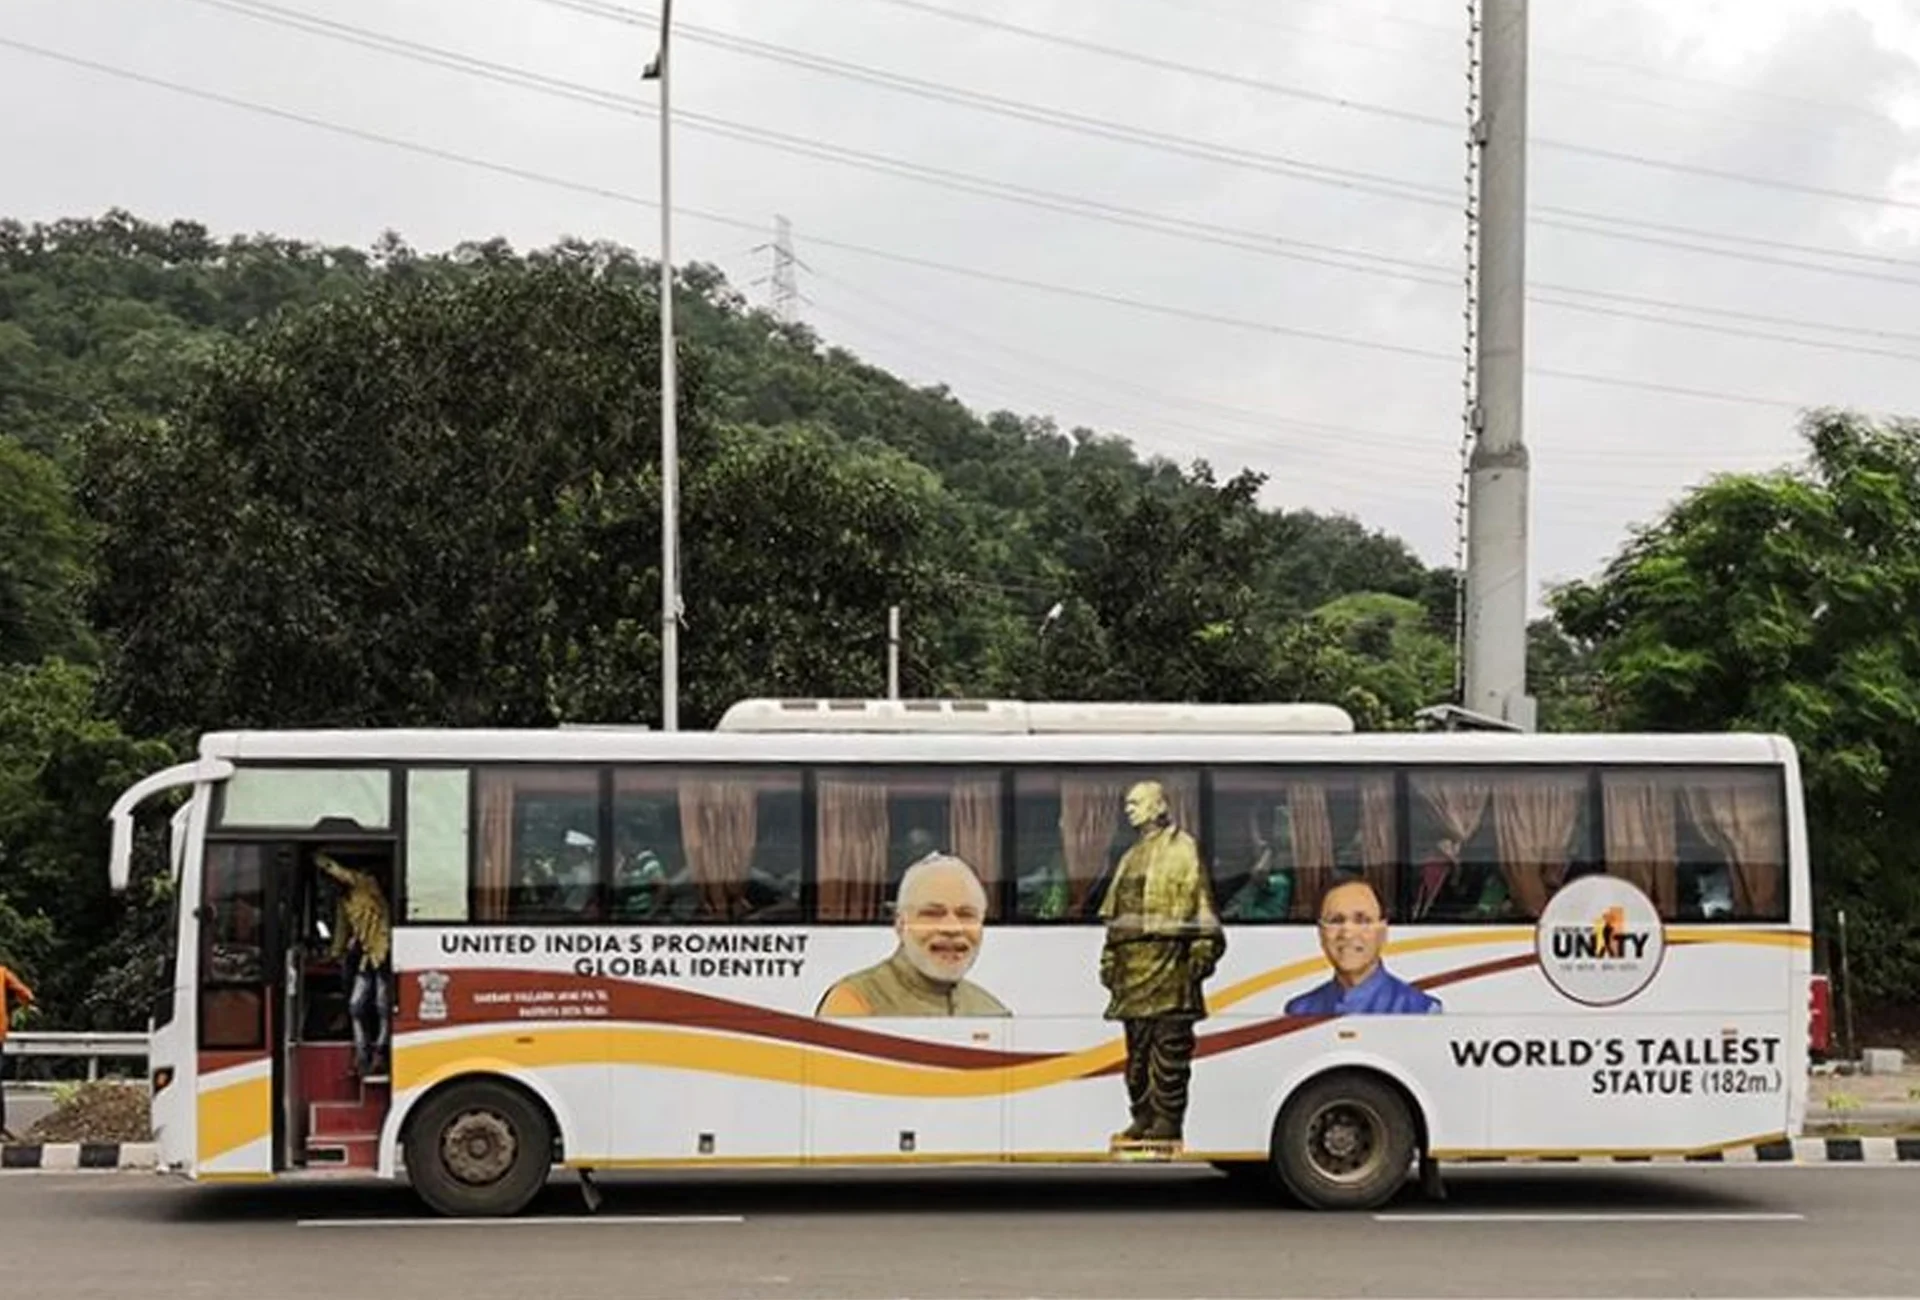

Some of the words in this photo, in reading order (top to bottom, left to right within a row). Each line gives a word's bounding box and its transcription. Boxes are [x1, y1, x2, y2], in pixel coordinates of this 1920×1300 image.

[441, 934, 536, 953] UNITED
[652, 933, 808, 953] PROMINENT
[574, 957, 680, 977] GLOBAL
[690, 958, 805, 977] IDENTITY
[1449, 1038, 1624, 1067] WORLD'S
[1636, 1038, 1781, 1066] TALLEST
[1592, 1069, 1693, 1095] STATUE
[1700, 1068, 1782, 1096] (182m.)
